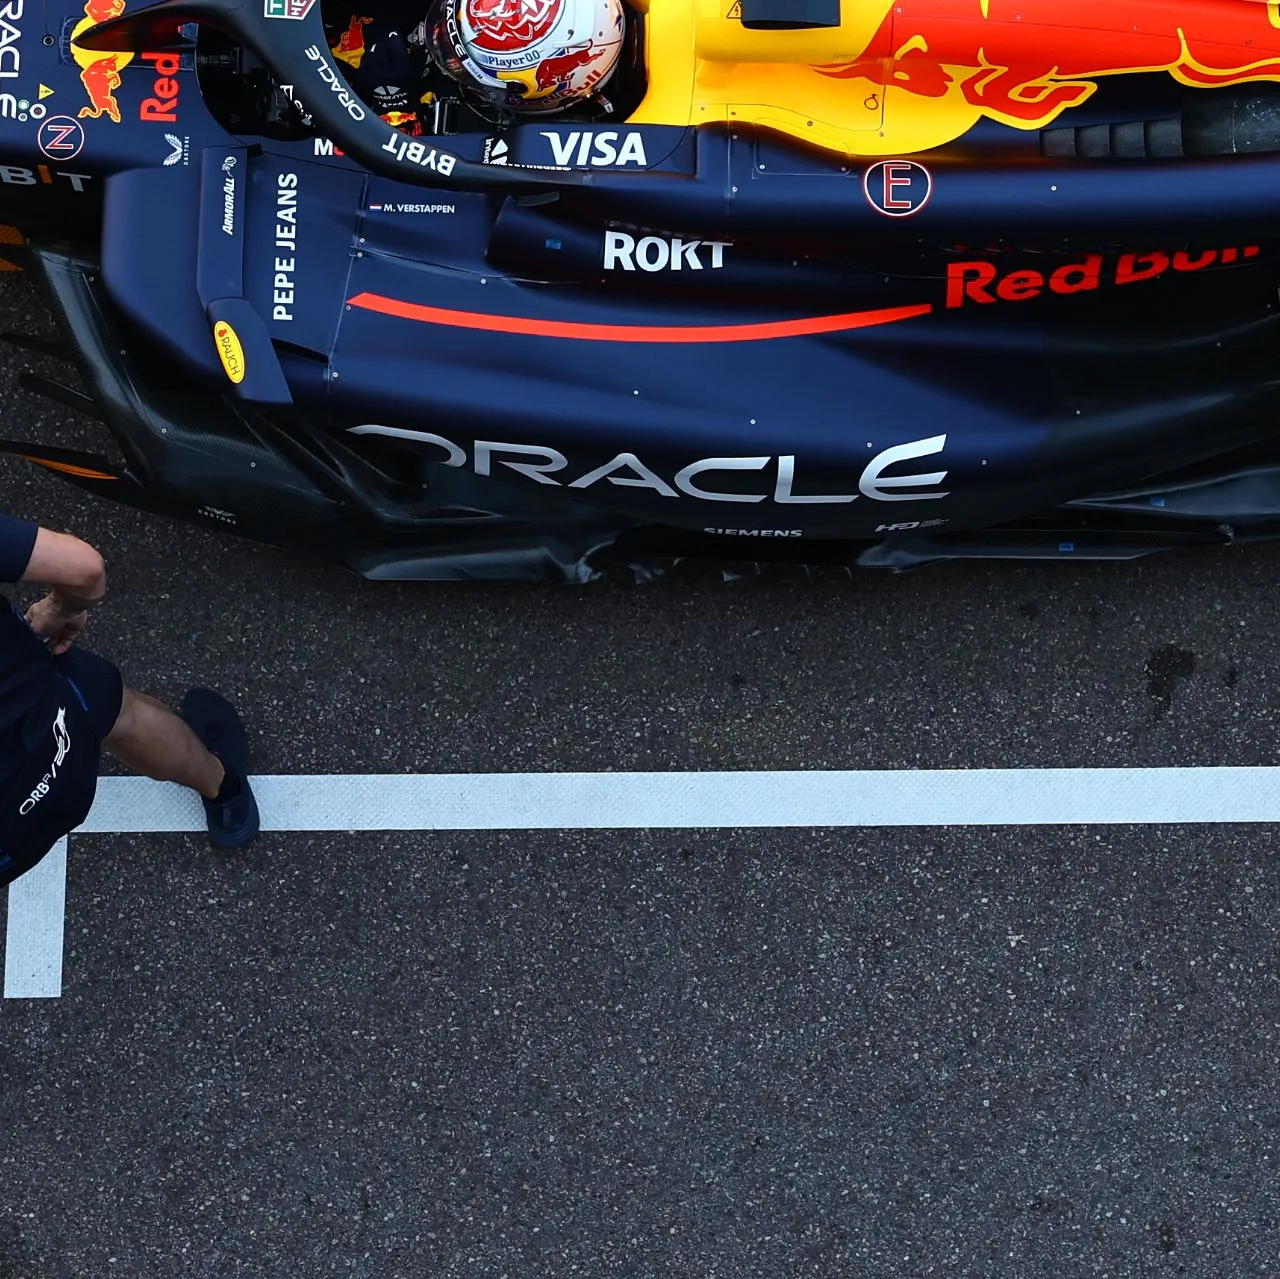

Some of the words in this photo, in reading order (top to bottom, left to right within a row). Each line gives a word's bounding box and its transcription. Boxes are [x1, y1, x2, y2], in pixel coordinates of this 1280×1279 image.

[305, 44, 365, 121] ORACLE
[487, 55, 525, 68] Player
[140, 52, 181, 122] Red
[381, 133, 457, 177] BYBIT
[539, 132, 648, 166] VISA
[882, 163, 913, 210] E
[276, 173, 298, 251] JEANS
[383, 205, 396, 213] M.
[397, 204, 456, 214] VERSTAPPEN
[603, 231, 733, 272] ROKT
[273, 257, 296, 320] PEPE
[946, 255, 1102, 309] Red
[1115, 245, 1260, 286] Bu
[220, 336, 239, 376] RAUCH
[703, 526, 804, 539] SIEMENS
